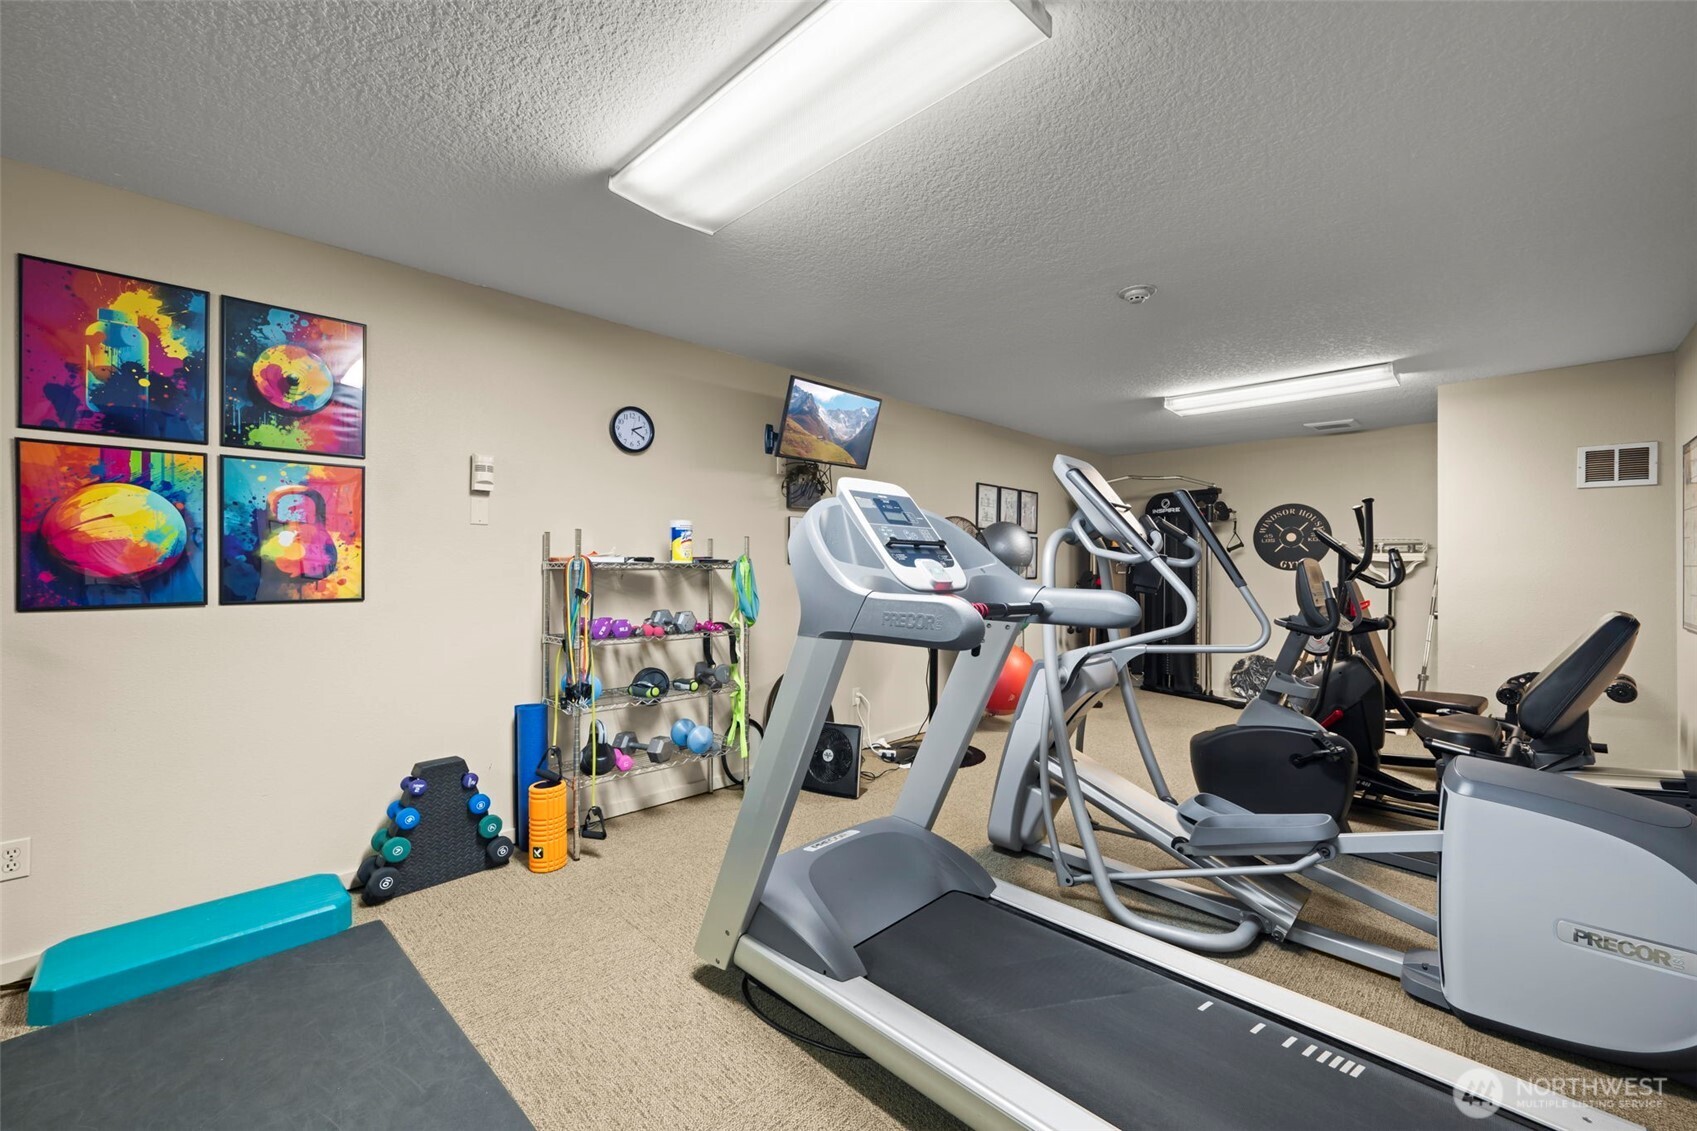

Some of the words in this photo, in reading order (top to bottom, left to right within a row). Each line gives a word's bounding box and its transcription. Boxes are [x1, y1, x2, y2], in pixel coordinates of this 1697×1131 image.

[629, 412, 636, 420] 12
[1152, 506, 1180, 515] INSPIRE
[1259, 508, 1296, 534] WINDSOR
[881, 610, 935, 631] PRECOR
[1573, 928, 1672, 967] PRECOR
